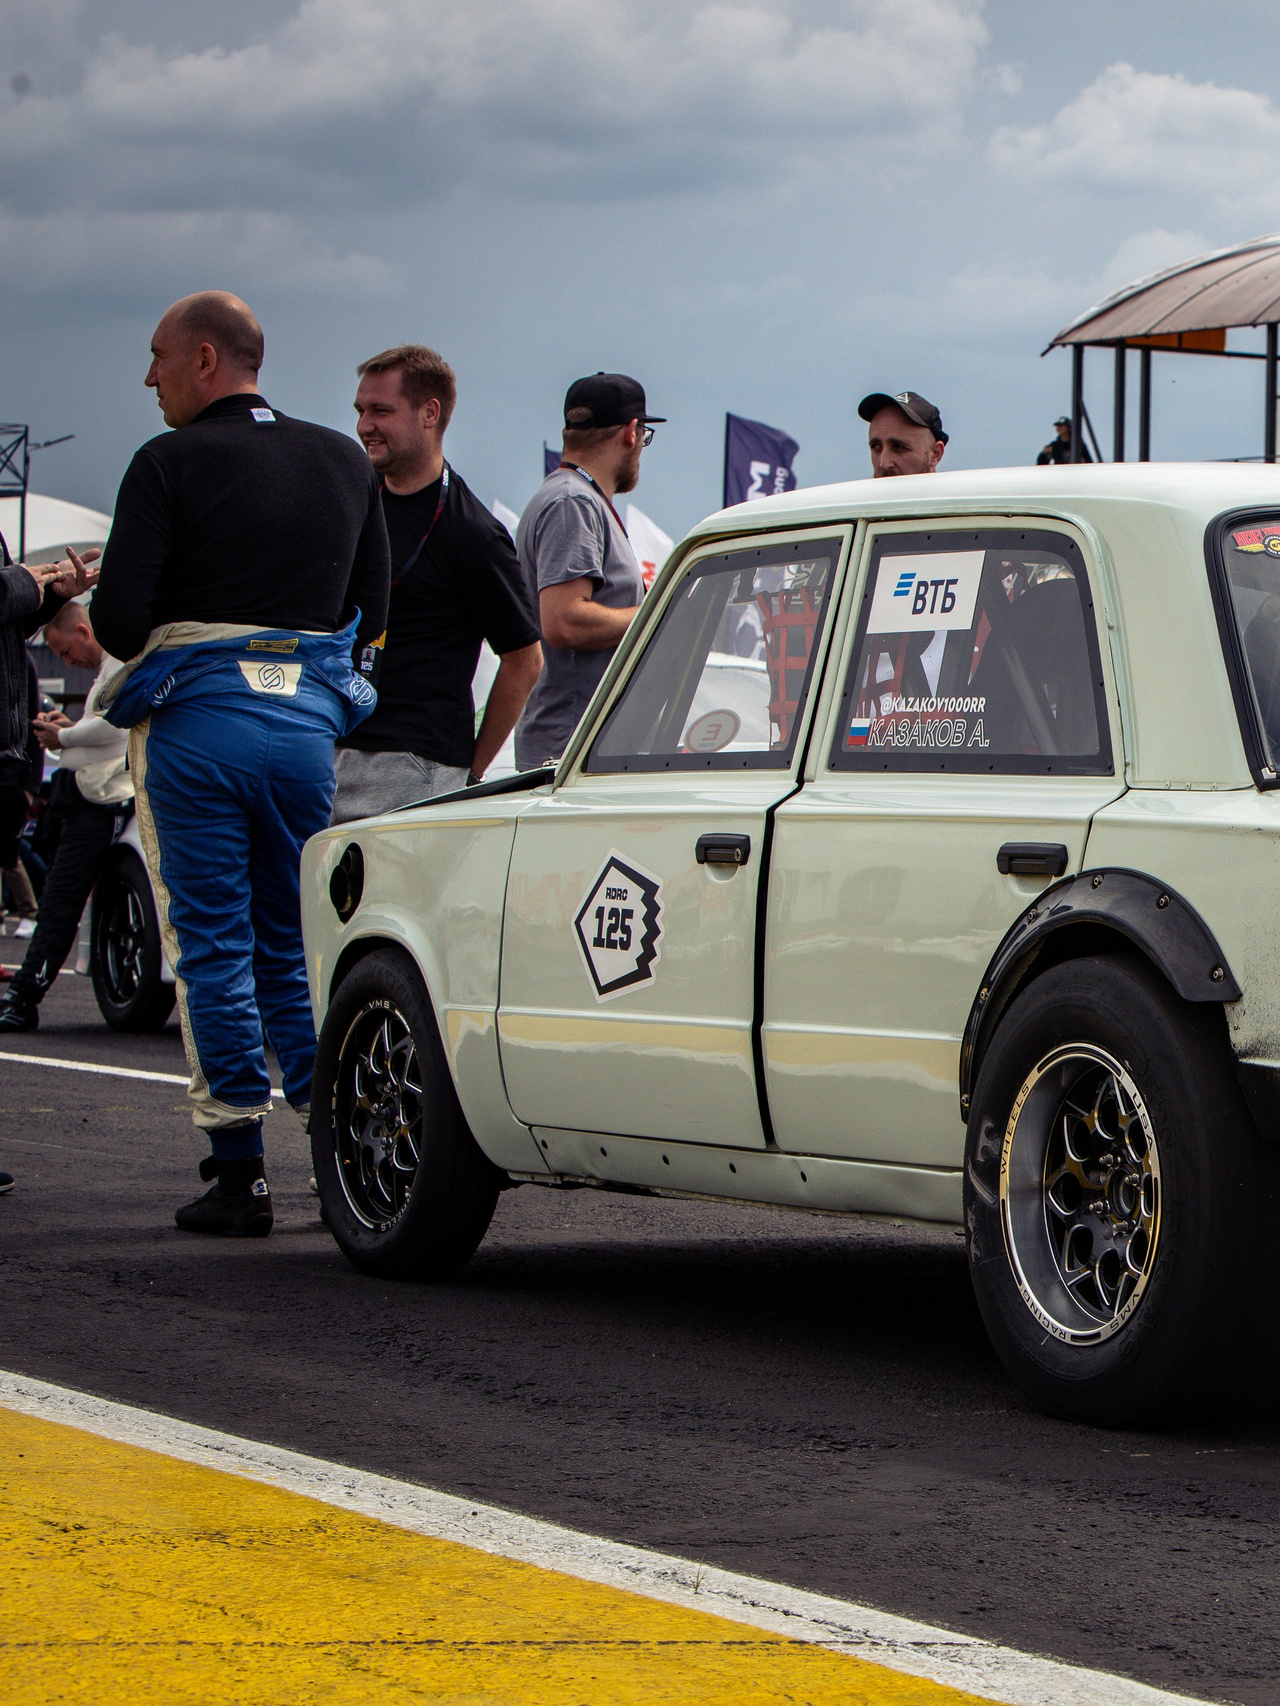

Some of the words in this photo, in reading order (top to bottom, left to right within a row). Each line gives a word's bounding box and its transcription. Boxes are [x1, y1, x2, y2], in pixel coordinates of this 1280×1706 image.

[912, 579, 959, 615] ВТБ
[882, 697, 986, 713] @KAZAKOV1000RR
[867, 718, 967, 747] КАЗАКОВ
[605, 886, 628, 901] RDRC
[592, 905, 634, 951] 125
[369, 1001, 390, 1009] VMS
[1000, 1083, 1030, 1176] WHEELS
[1132, 1092, 1154, 1149] USA
[1020, 1288, 1067, 1341] RACING
[1110, 1291, 1141, 1333] VMS
